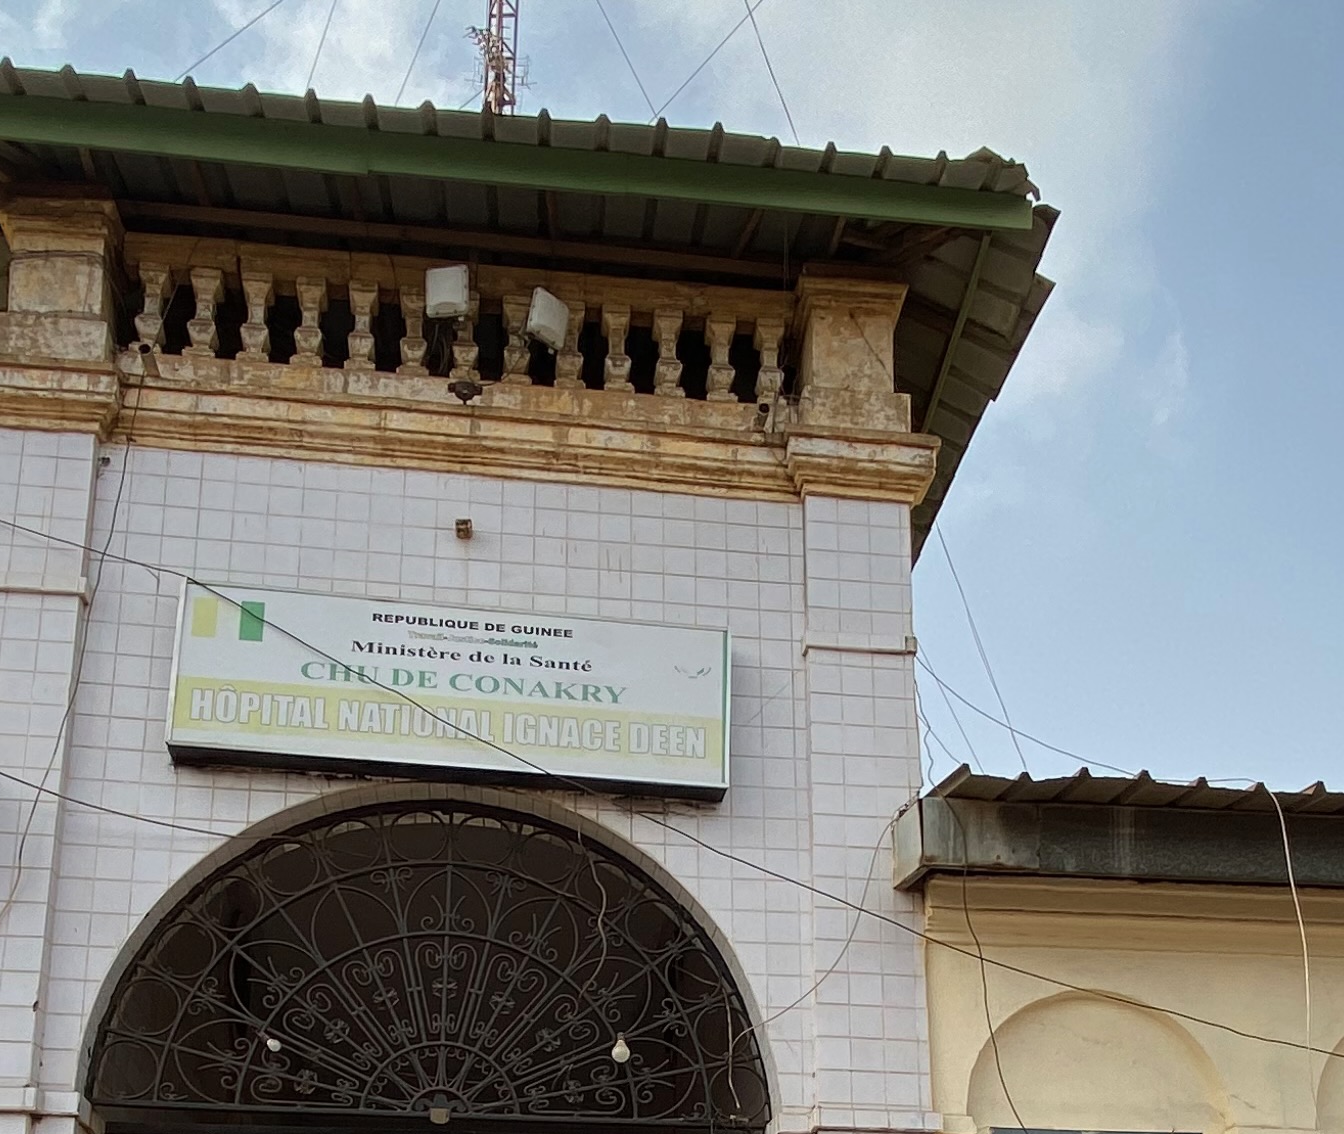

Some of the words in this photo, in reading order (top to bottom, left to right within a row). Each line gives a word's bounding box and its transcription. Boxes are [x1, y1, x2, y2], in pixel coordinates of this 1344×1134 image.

[372, 613, 479, 631] REPUBLIQUE
[484, 622, 506, 633] DE
[511, 625, 574, 639] GUINEE
[351, 640, 461, 661] Ministère
[469, 651, 495, 664] de
[502, 653, 522, 666] la
[529, 655, 593, 672] Santé
[301, 661, 378, 684] CHU
[391, 668, 438, 689] DE
[449, 673, 627, 704] CONAKRY
[189, 684, 329, 730] HÔPITAL
[337, 699, 494, 744] NATIONAL
[503, 711, 621, 752] IGNACE
[628, 722, 706, 759] DEEN
